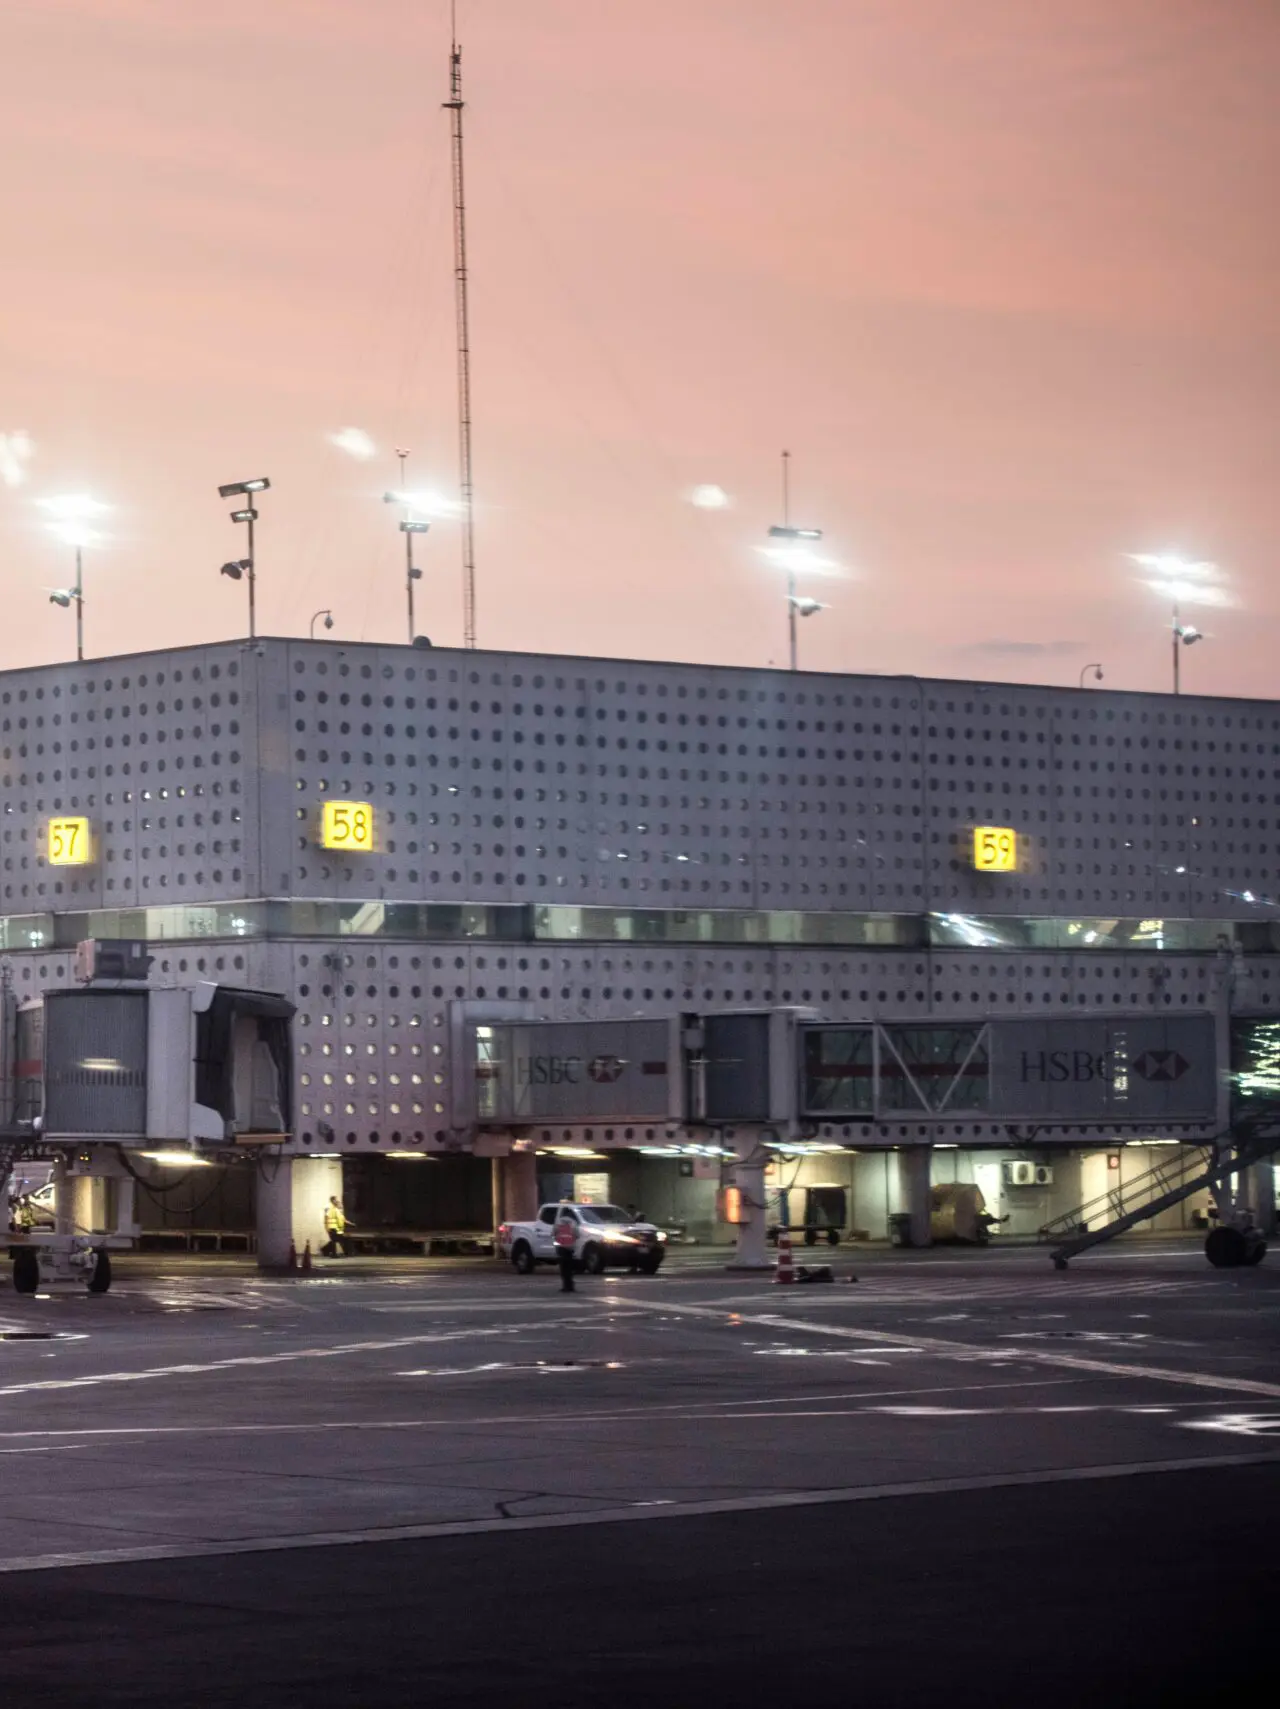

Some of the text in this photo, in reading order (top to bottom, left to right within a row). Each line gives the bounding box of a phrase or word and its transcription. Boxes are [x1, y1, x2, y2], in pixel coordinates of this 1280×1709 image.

[53, 823, 79, 857] 57
[332, 808, 367, 843] 58
[982, 833, 1010, 865] 59
[518, 1056, 580, 1084] HSBC
[1021, 1051, 1115, 1083] HSBC
